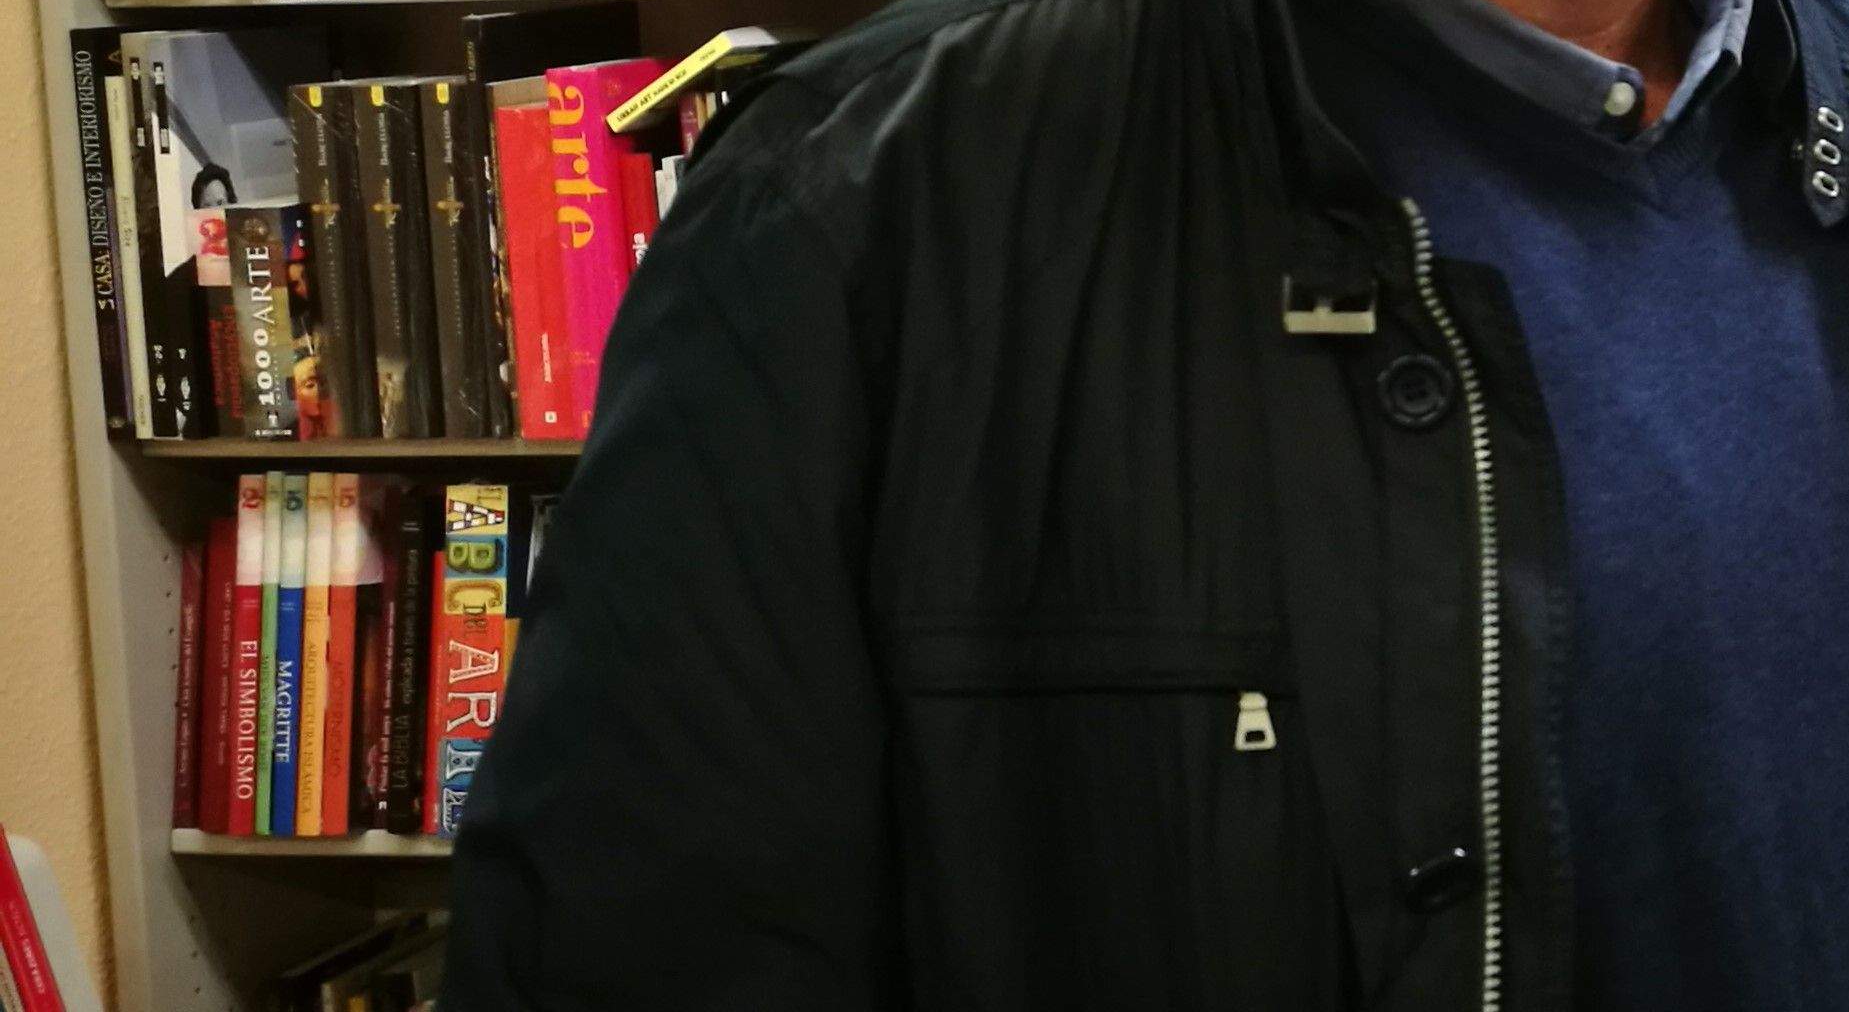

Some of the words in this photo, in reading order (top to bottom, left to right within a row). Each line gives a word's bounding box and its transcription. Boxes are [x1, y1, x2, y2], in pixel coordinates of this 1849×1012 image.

[75, 50, 100, 169] INTERIORISMO
[547, 84, 608, 250] arte
[246, 244, 276, 325] ARTE
[256, 328, 277, 407] 1000
[239, 639, 258, 663] EL
[236, 666, 257, 801] SIMBOLISMO
[275, 659, 294, 764] MAGRITTE
